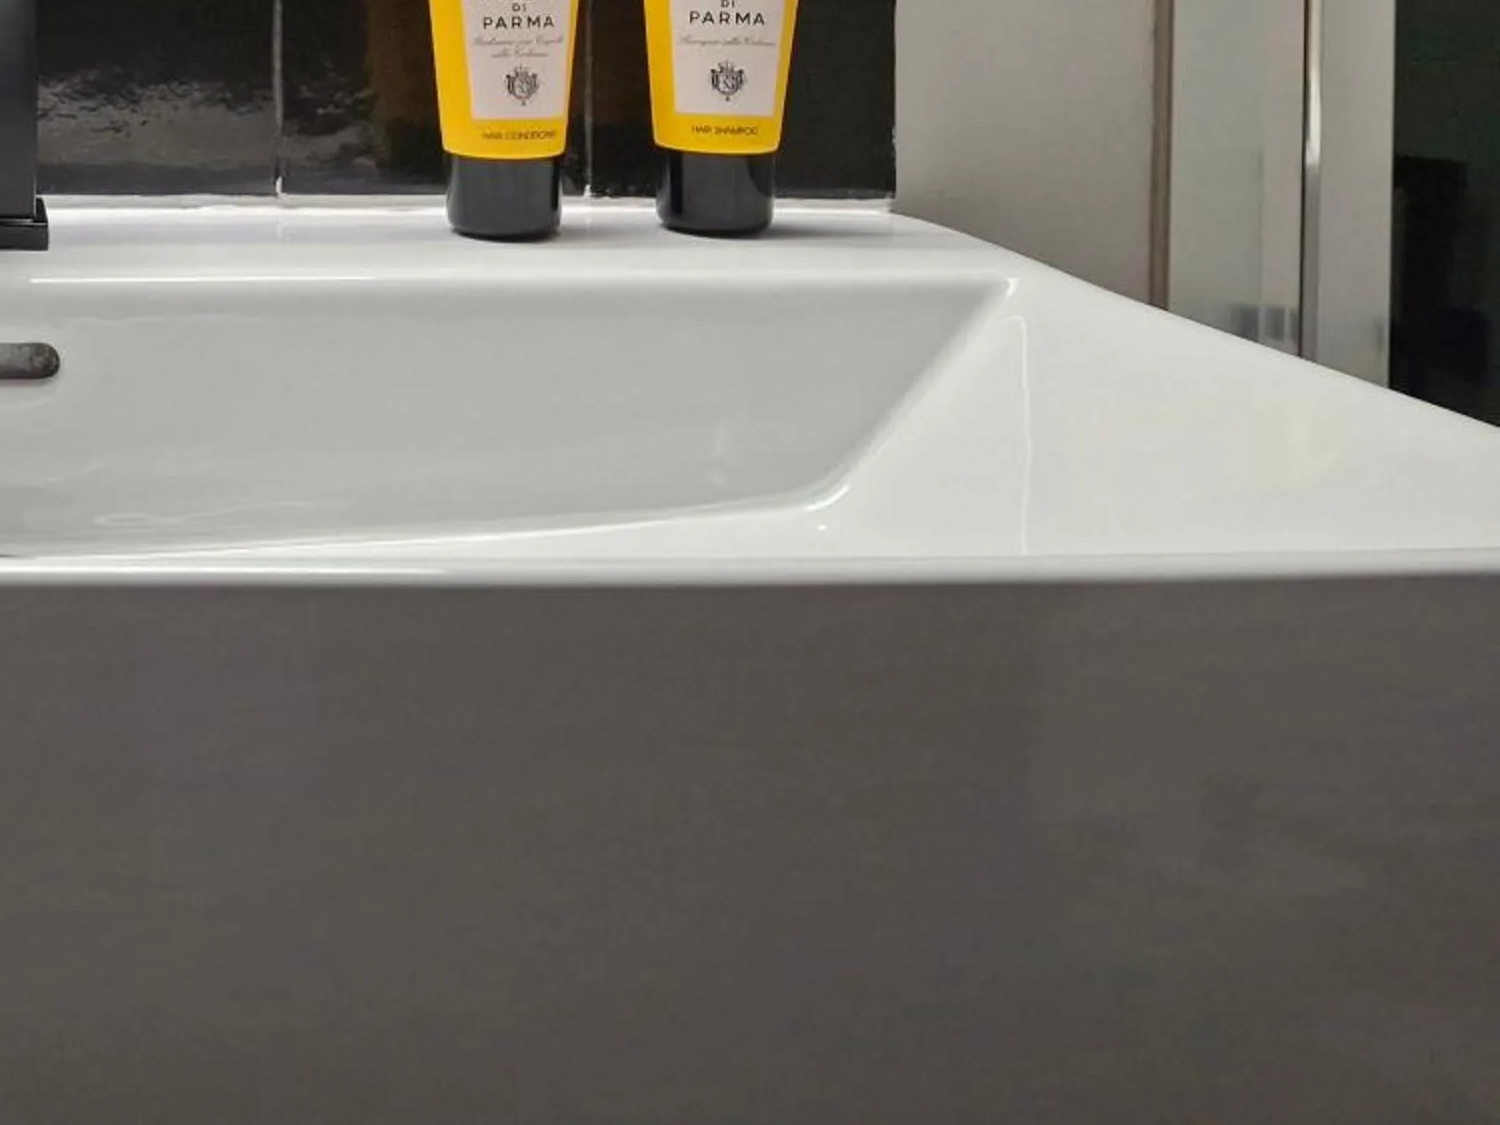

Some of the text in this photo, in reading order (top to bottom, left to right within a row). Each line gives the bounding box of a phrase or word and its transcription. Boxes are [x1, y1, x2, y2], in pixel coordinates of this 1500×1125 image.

[511, 2, 527, 12] DI
[483, 15, 555, 30] PARMA
[689, 10, 765, 26] PARMA
